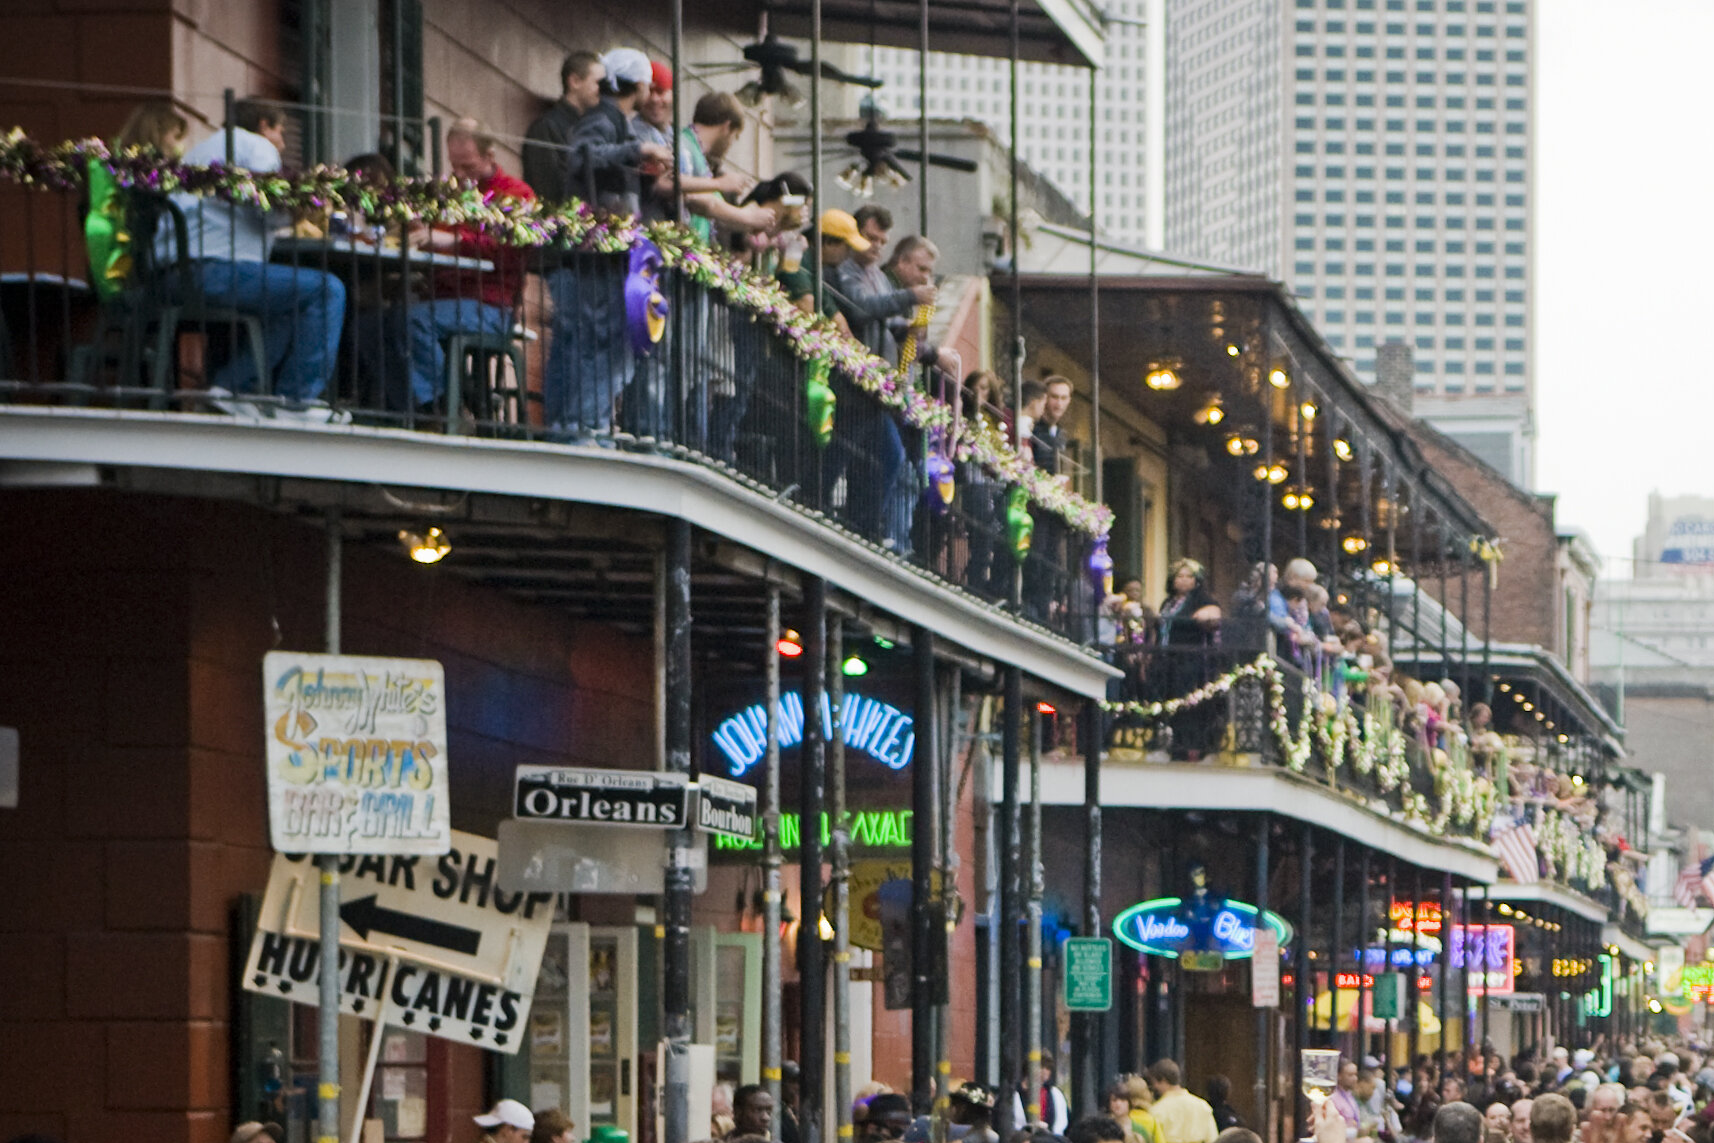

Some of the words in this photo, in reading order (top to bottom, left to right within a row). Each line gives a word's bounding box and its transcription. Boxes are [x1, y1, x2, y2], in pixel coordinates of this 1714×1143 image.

[556, 772, 580, 785] Rue
[602, 776, 648, 788] Orleans
[524, 788, 677, 824] Orleans
[701, 797, 752, 835] Bourbon
[1135, 914, 1190, 942] Voodoo
